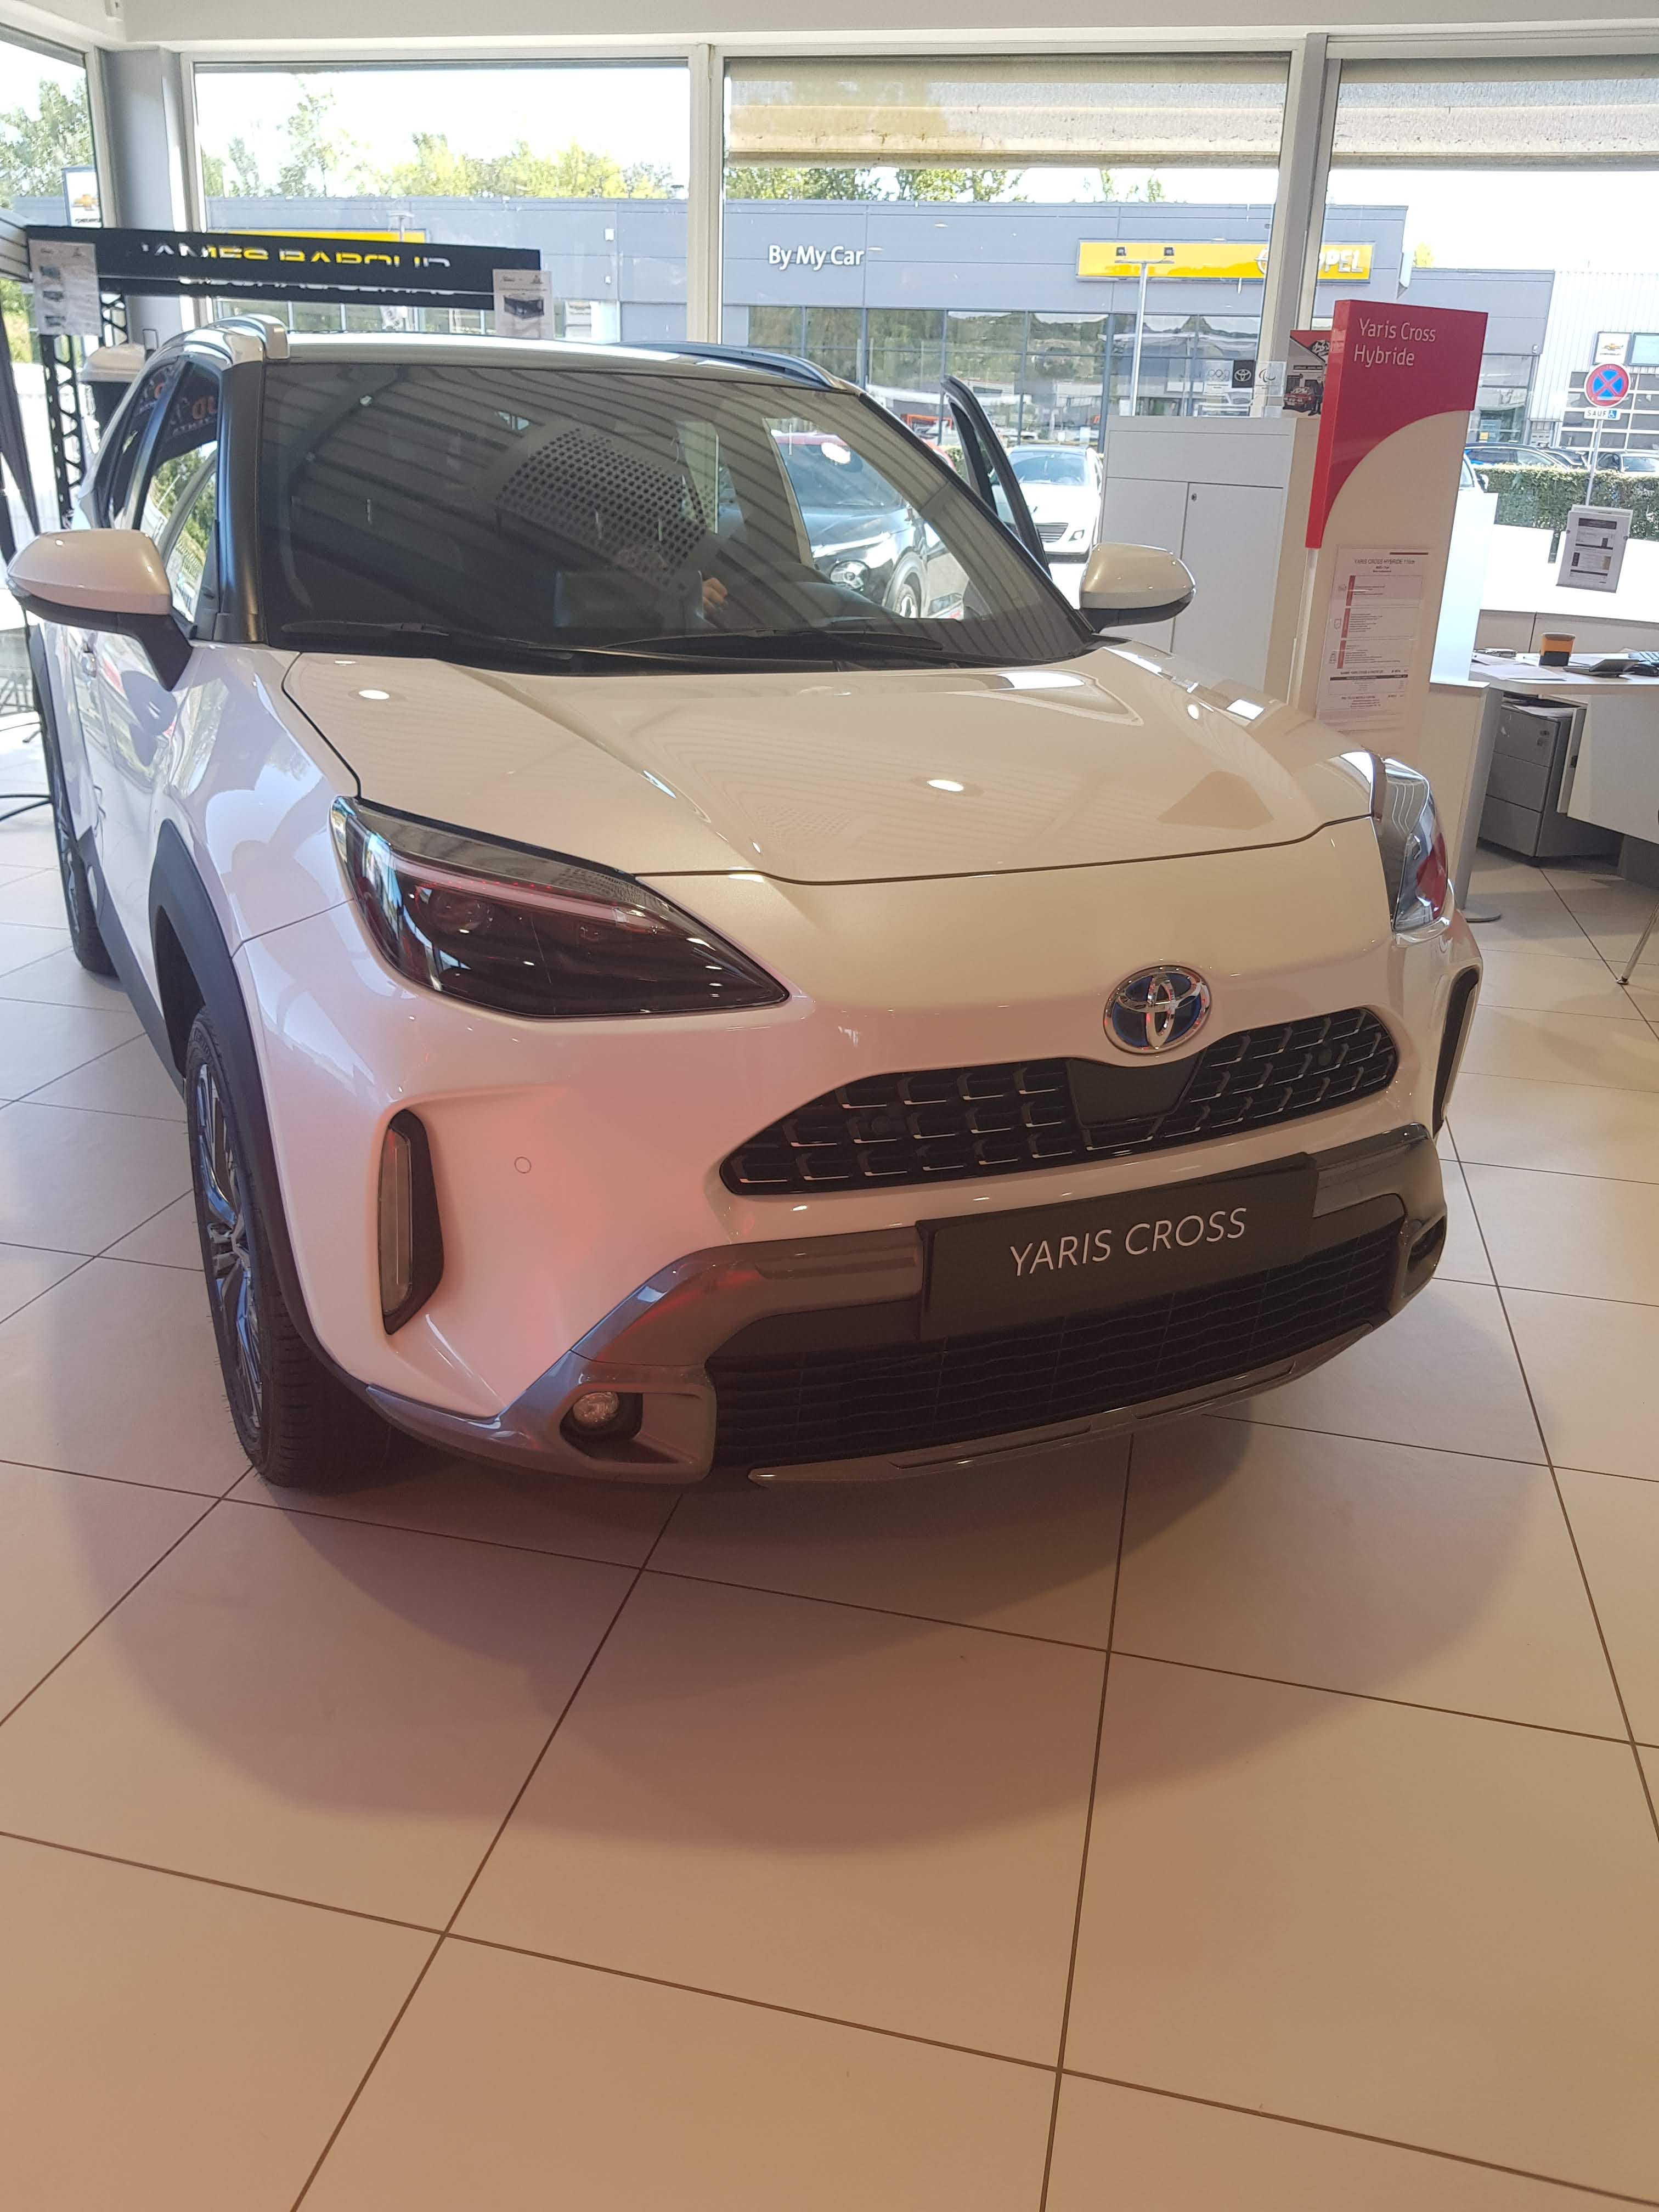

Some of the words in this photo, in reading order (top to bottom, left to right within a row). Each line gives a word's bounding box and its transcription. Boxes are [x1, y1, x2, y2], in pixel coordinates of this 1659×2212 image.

[769, 245, 792, 270] By
[796, 245, 827, 271] My
[831, 246, 865, 266] Car
[1359, 318, 1396, 339] Yaris
[1401, 322, 1436, 342] Cross
[1353, 344, 1415, 368] Hybride
[1009, 1229, 1112, 1277] YARIS
[1125, 1207, 1247, 1256] CROSS
